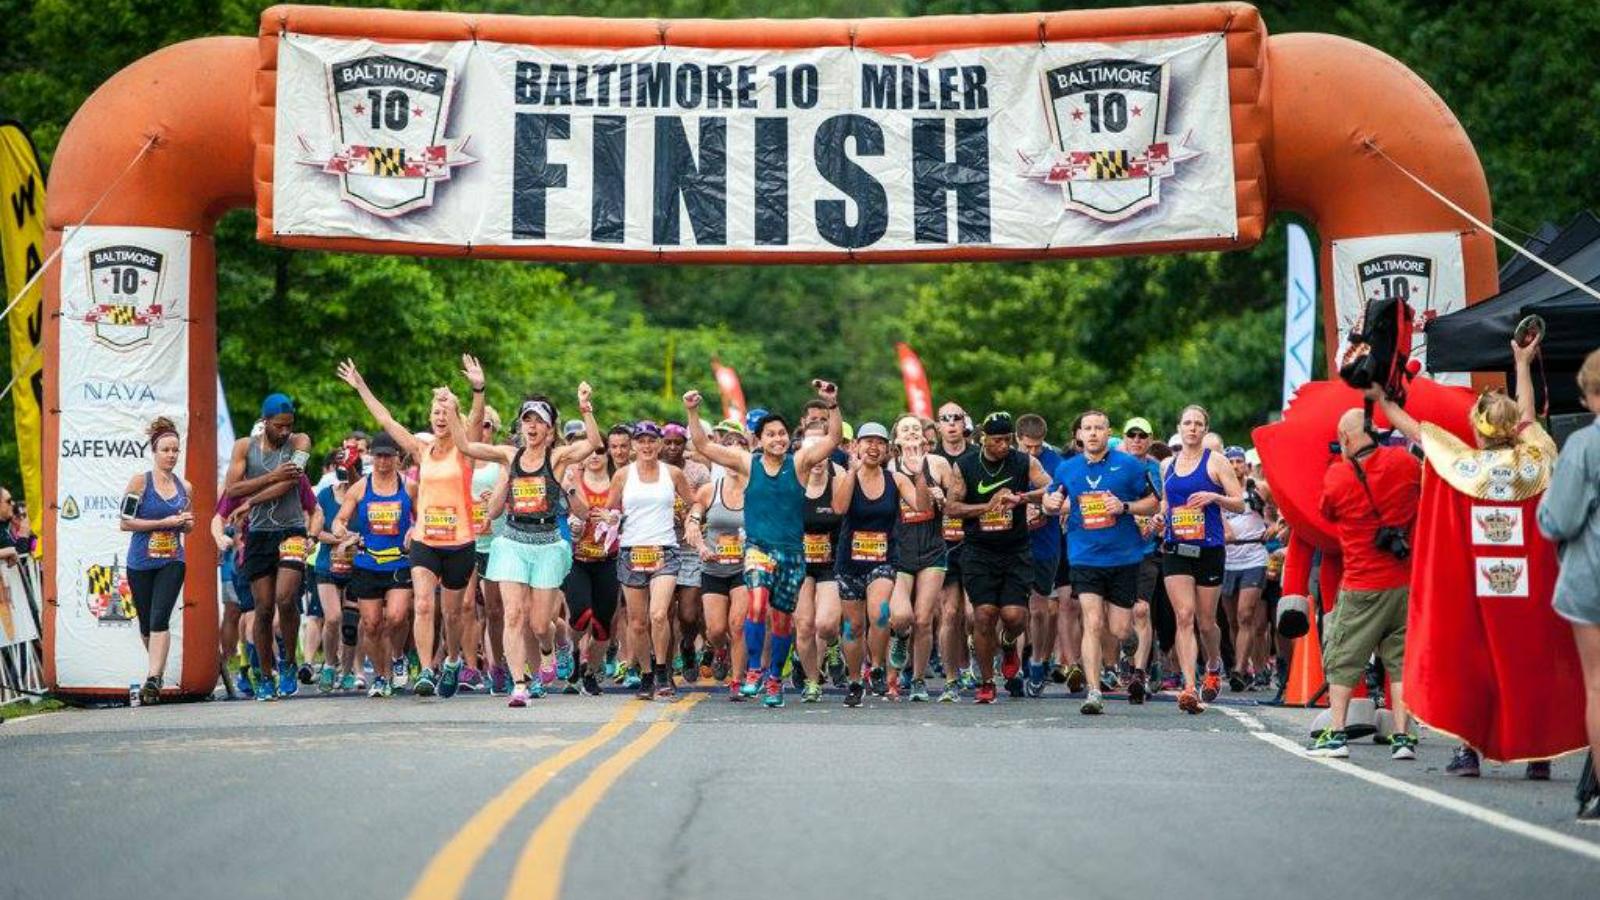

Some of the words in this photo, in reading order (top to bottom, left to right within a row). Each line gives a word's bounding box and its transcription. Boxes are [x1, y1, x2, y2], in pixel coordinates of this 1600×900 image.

[342, 64, 437, 87] BALTIMORE
[514, 60, 758, 109] BALTIMORE
[769, 64, 818, 109] 10
[861, 64, 989, 110] MILER
[1056, 67, 1153, 89] BALTIMORE
[367, 89, 409, 131] 10
[1084, 92, 1128, 133] 10
[512, 112, 992, 249] FINISH
[95, 250, 157, 267] BALTIMORE
[1363, 260, 1426, 275] BALTIMORE
[110, 267, 139, 295] 10
[1380, 276, 1410, 301] 10
[83, 382, 156, 401] NAVA
[61, 440, 149, 459] SAFEWAY
